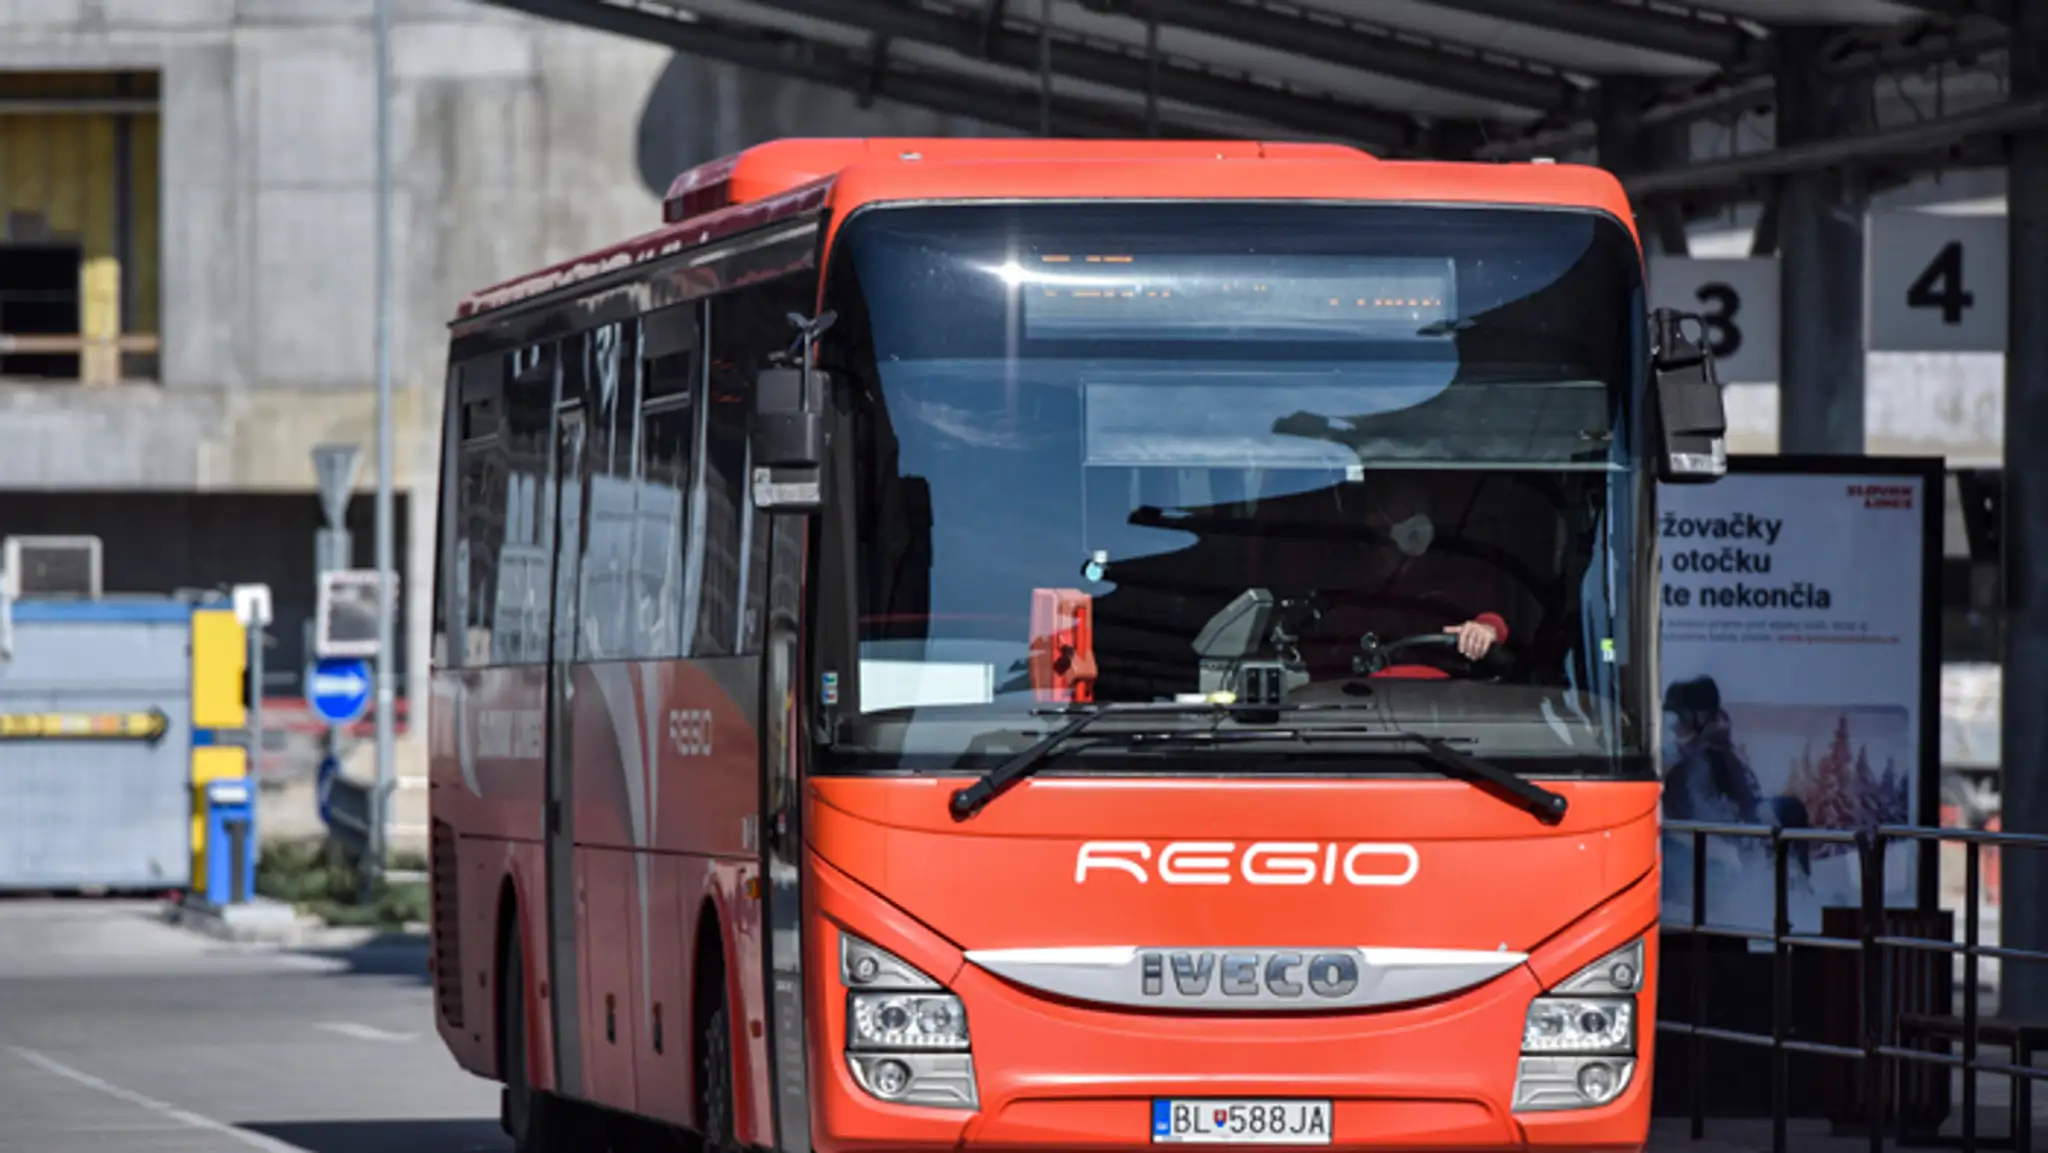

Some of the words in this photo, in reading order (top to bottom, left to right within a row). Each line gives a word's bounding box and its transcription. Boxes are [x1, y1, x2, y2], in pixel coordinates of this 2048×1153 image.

[1907, 240, 1974, 326] 4
[1695, 282, 1742, 357] 3
[1660, 511, 1782, 545] žovačky
[1672, 547, 1771, 573] otočku
[1701, 580, 1832, 609] nekončia
[1075, 841, 1420, 885] REGIO
[1141, 952, 1359, 998] IVECO
[1173, 1105, 1211, 1134] BL
[1228, 1105, 1325, 1134] 588JA
